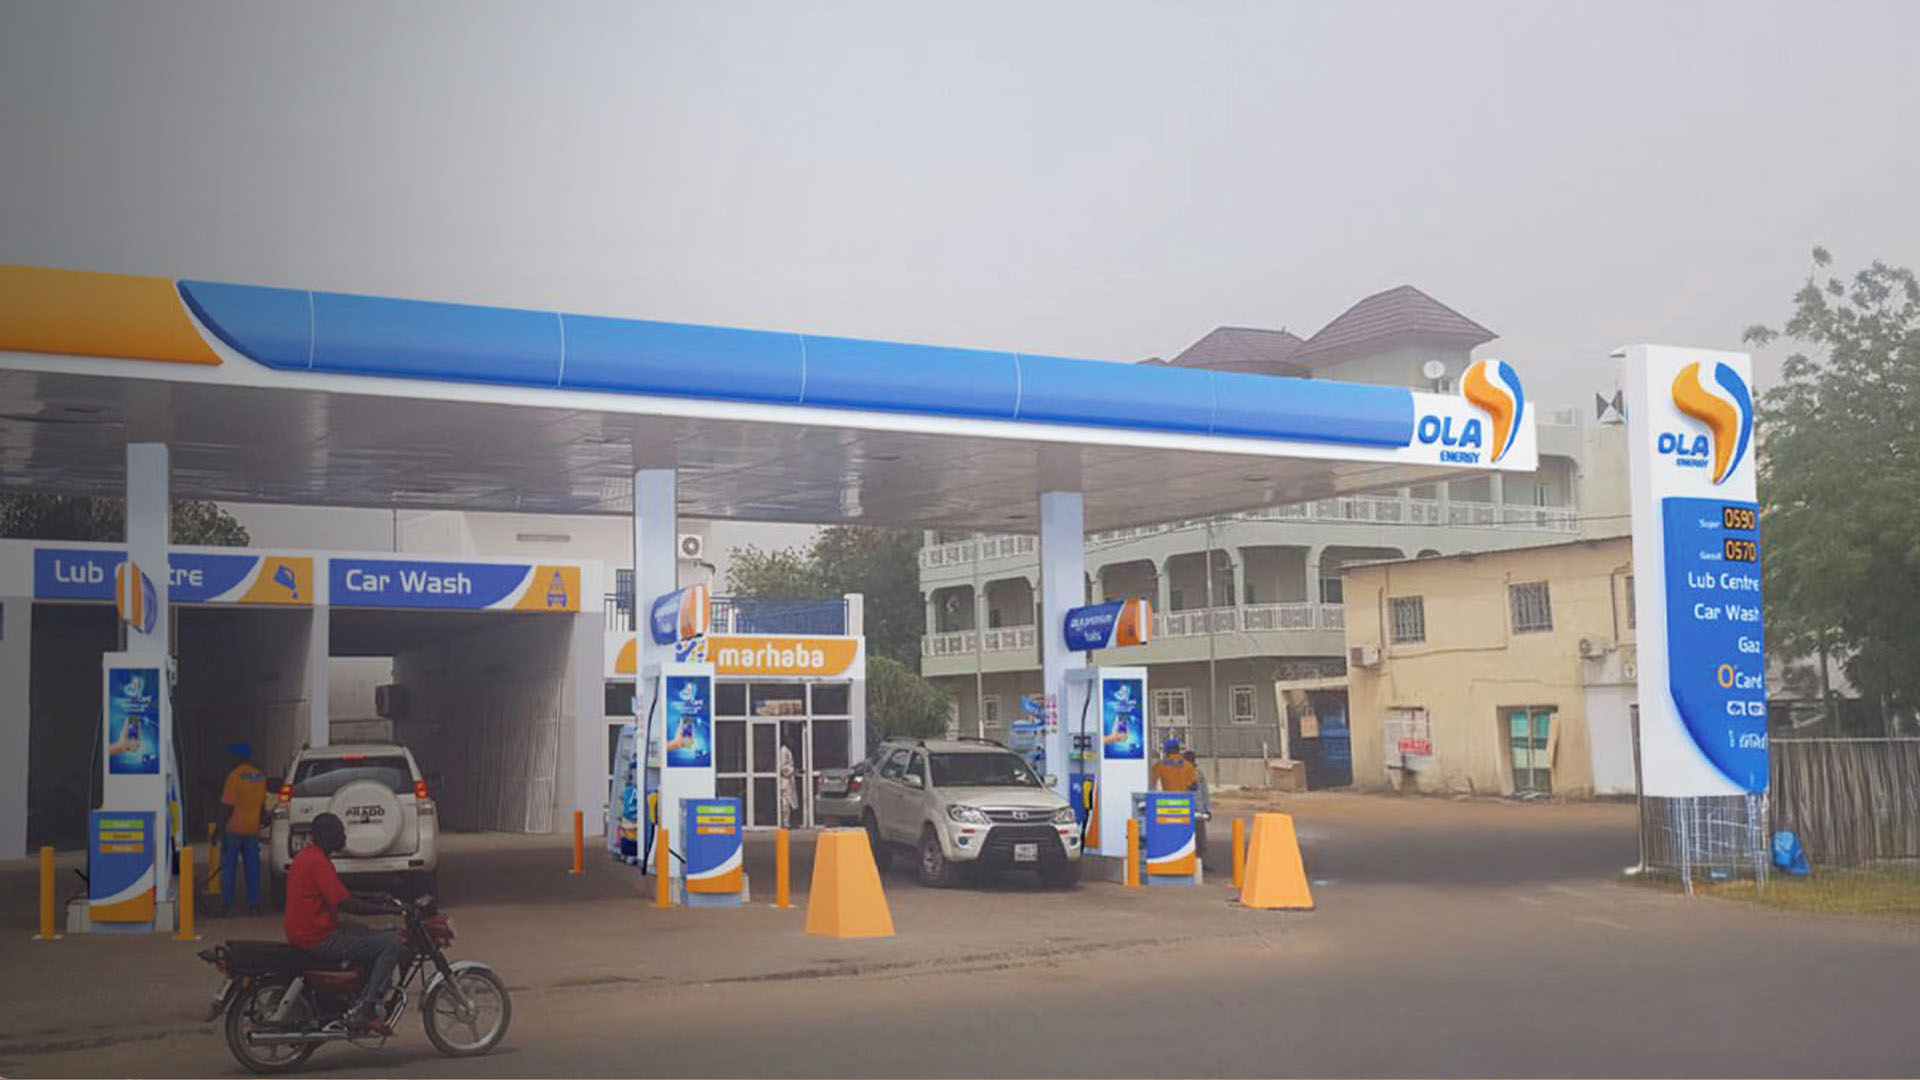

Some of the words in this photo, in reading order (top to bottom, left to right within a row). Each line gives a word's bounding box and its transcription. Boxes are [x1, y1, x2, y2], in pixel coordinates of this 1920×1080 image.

[1418, 415, 1481, 448] OLA
[1658, 432, 1708, 457] OLA
[1440, 450, 1480, 463] ENERGY
[1724, 508, 1756, 529] 0590
[1725, 540, 1757, 562] 0570
[55, 560, 104, 583] Lub
[346, 569, 390, 591] Car
[400, 570, 472, 594] Wash
[1688, 571, 1716, 588] Lub
[1720, 573, 1760, 591] Centre
[1694, 603, 1720, 620] Car
[718, 642, 824, 668] marhaba
[1738, 637, 1761, 653] Gaz
